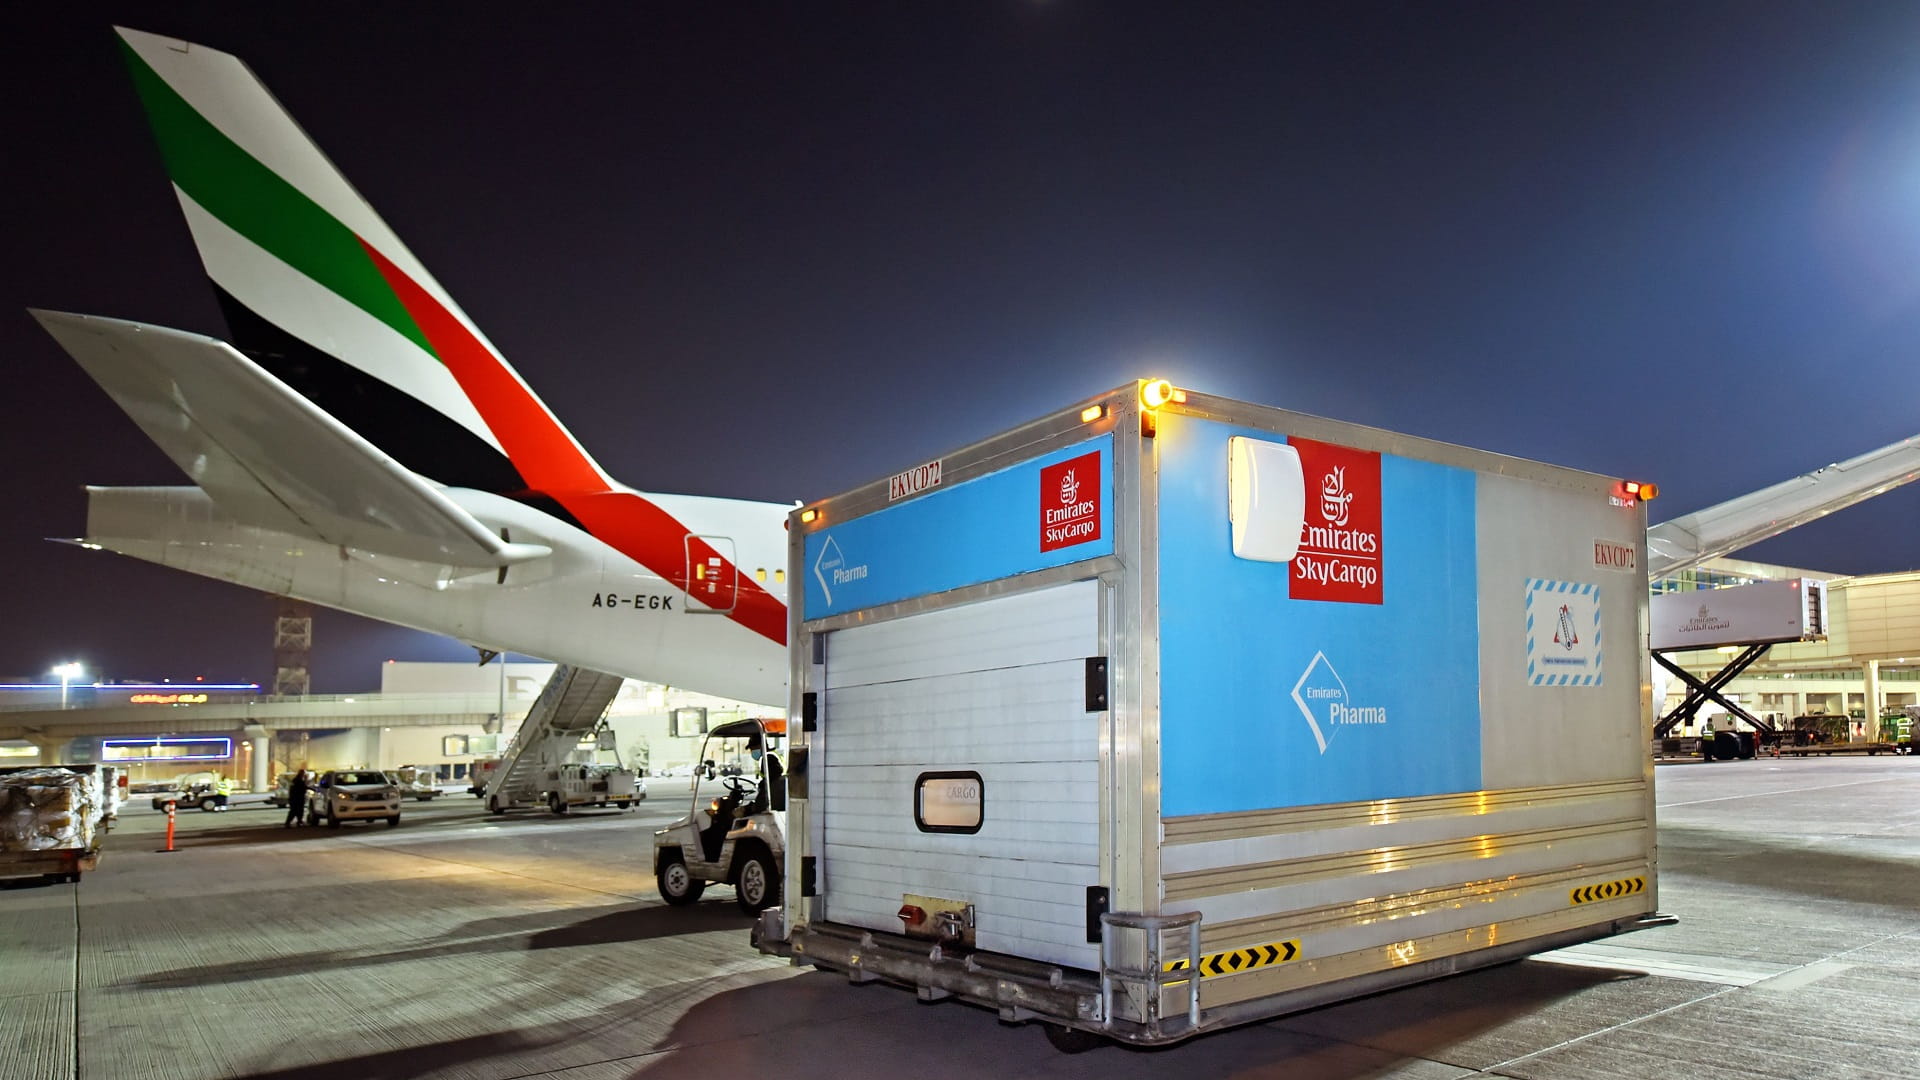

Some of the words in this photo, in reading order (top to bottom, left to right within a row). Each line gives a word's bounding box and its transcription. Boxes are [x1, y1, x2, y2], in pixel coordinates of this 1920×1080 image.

[891, 461, 941, 500] EKVCD72
[1046, 500, 1094, 524] Emirates
[1046, 521, 1094, 543] SkyCargo
[1595, 543, 1634, 568] EKVCD72
[833, 564, 868, 585] Pharma
[1296, 556, 1377, 589] SkyCargo
[592, 592, 673, 610] A6-EGK
[1306, 686, 1342, 699] Emirates
[1330, 702, 1387, 725] Pharma
